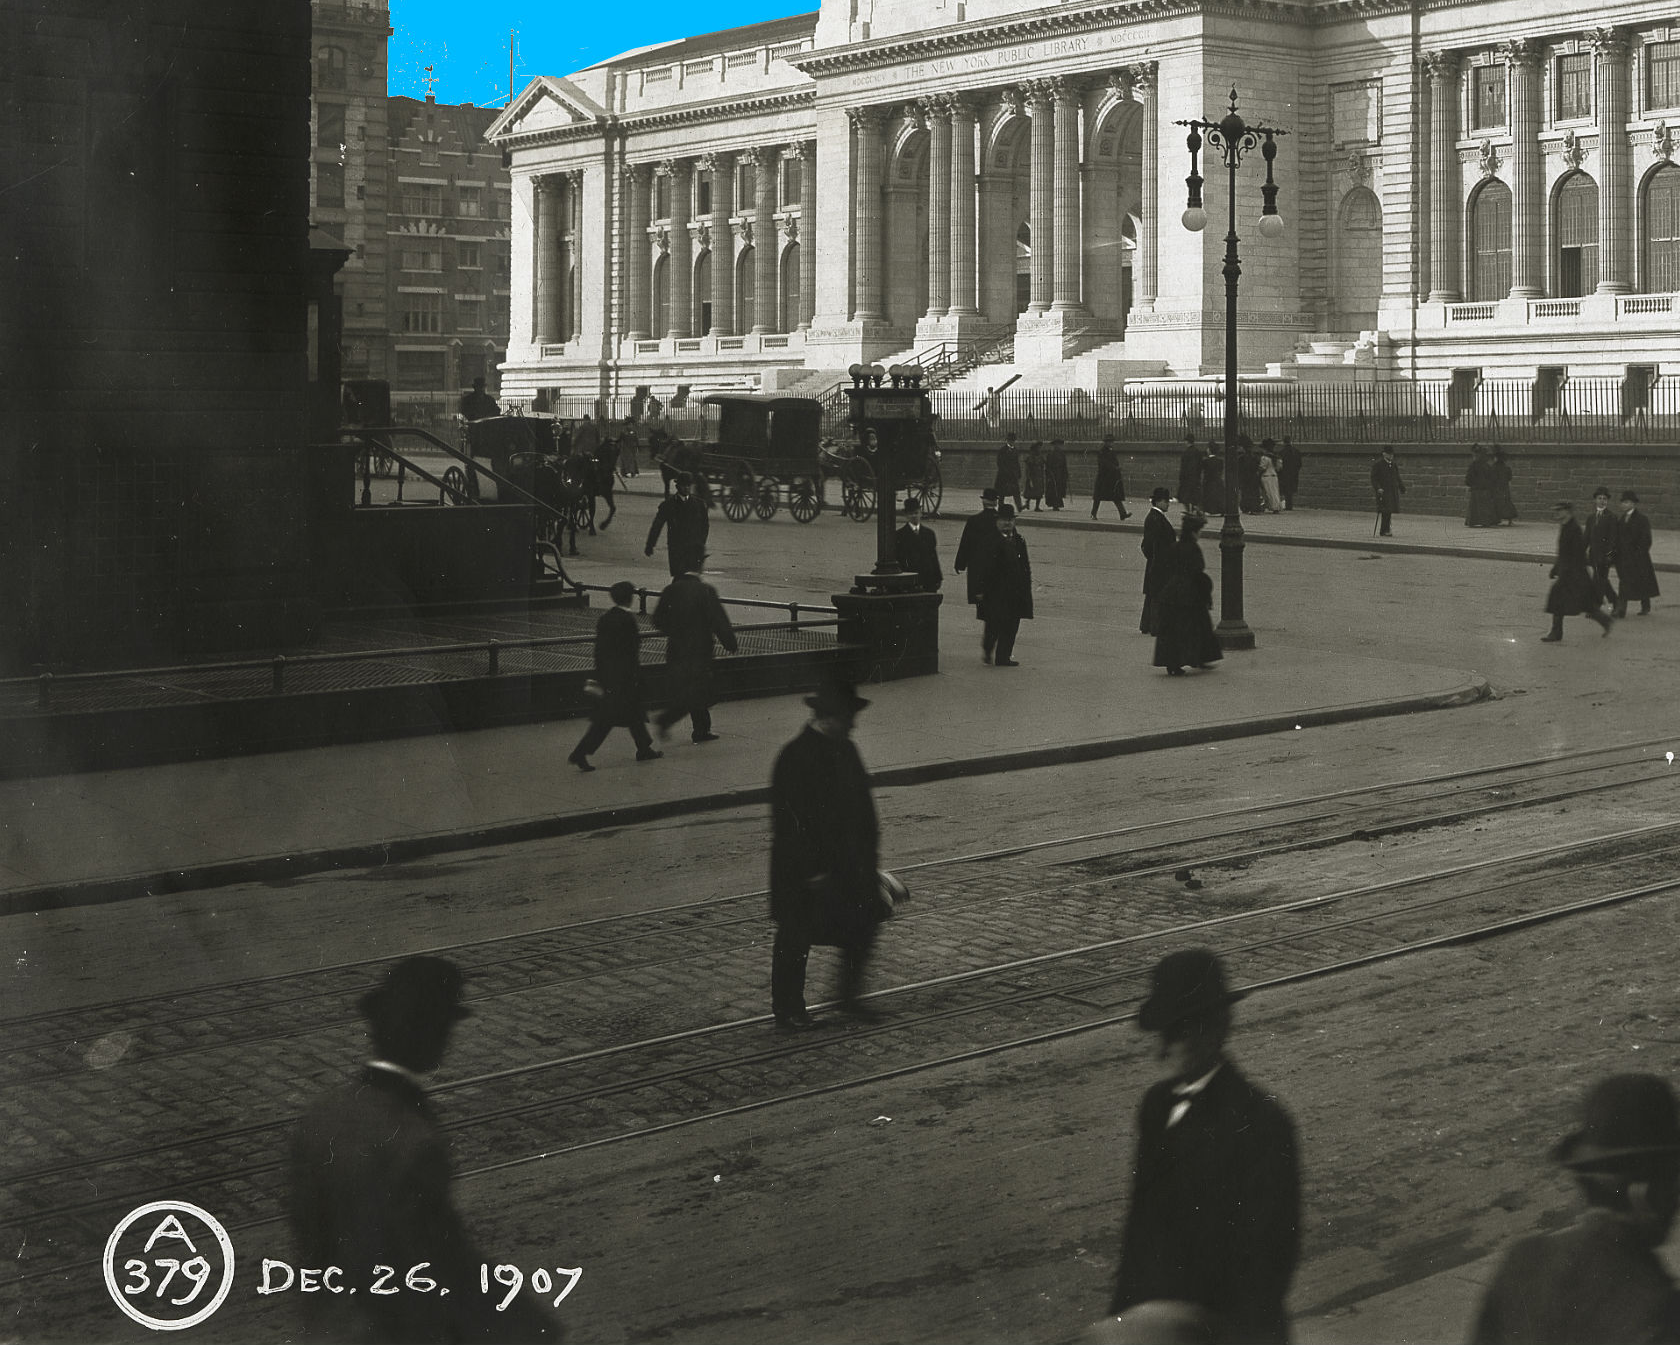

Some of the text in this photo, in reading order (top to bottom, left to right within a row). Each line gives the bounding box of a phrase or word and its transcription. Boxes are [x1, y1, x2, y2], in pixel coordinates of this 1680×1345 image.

[905, 37, 1089, 79] THE NEW YORK PUBLIC LIBRARY
